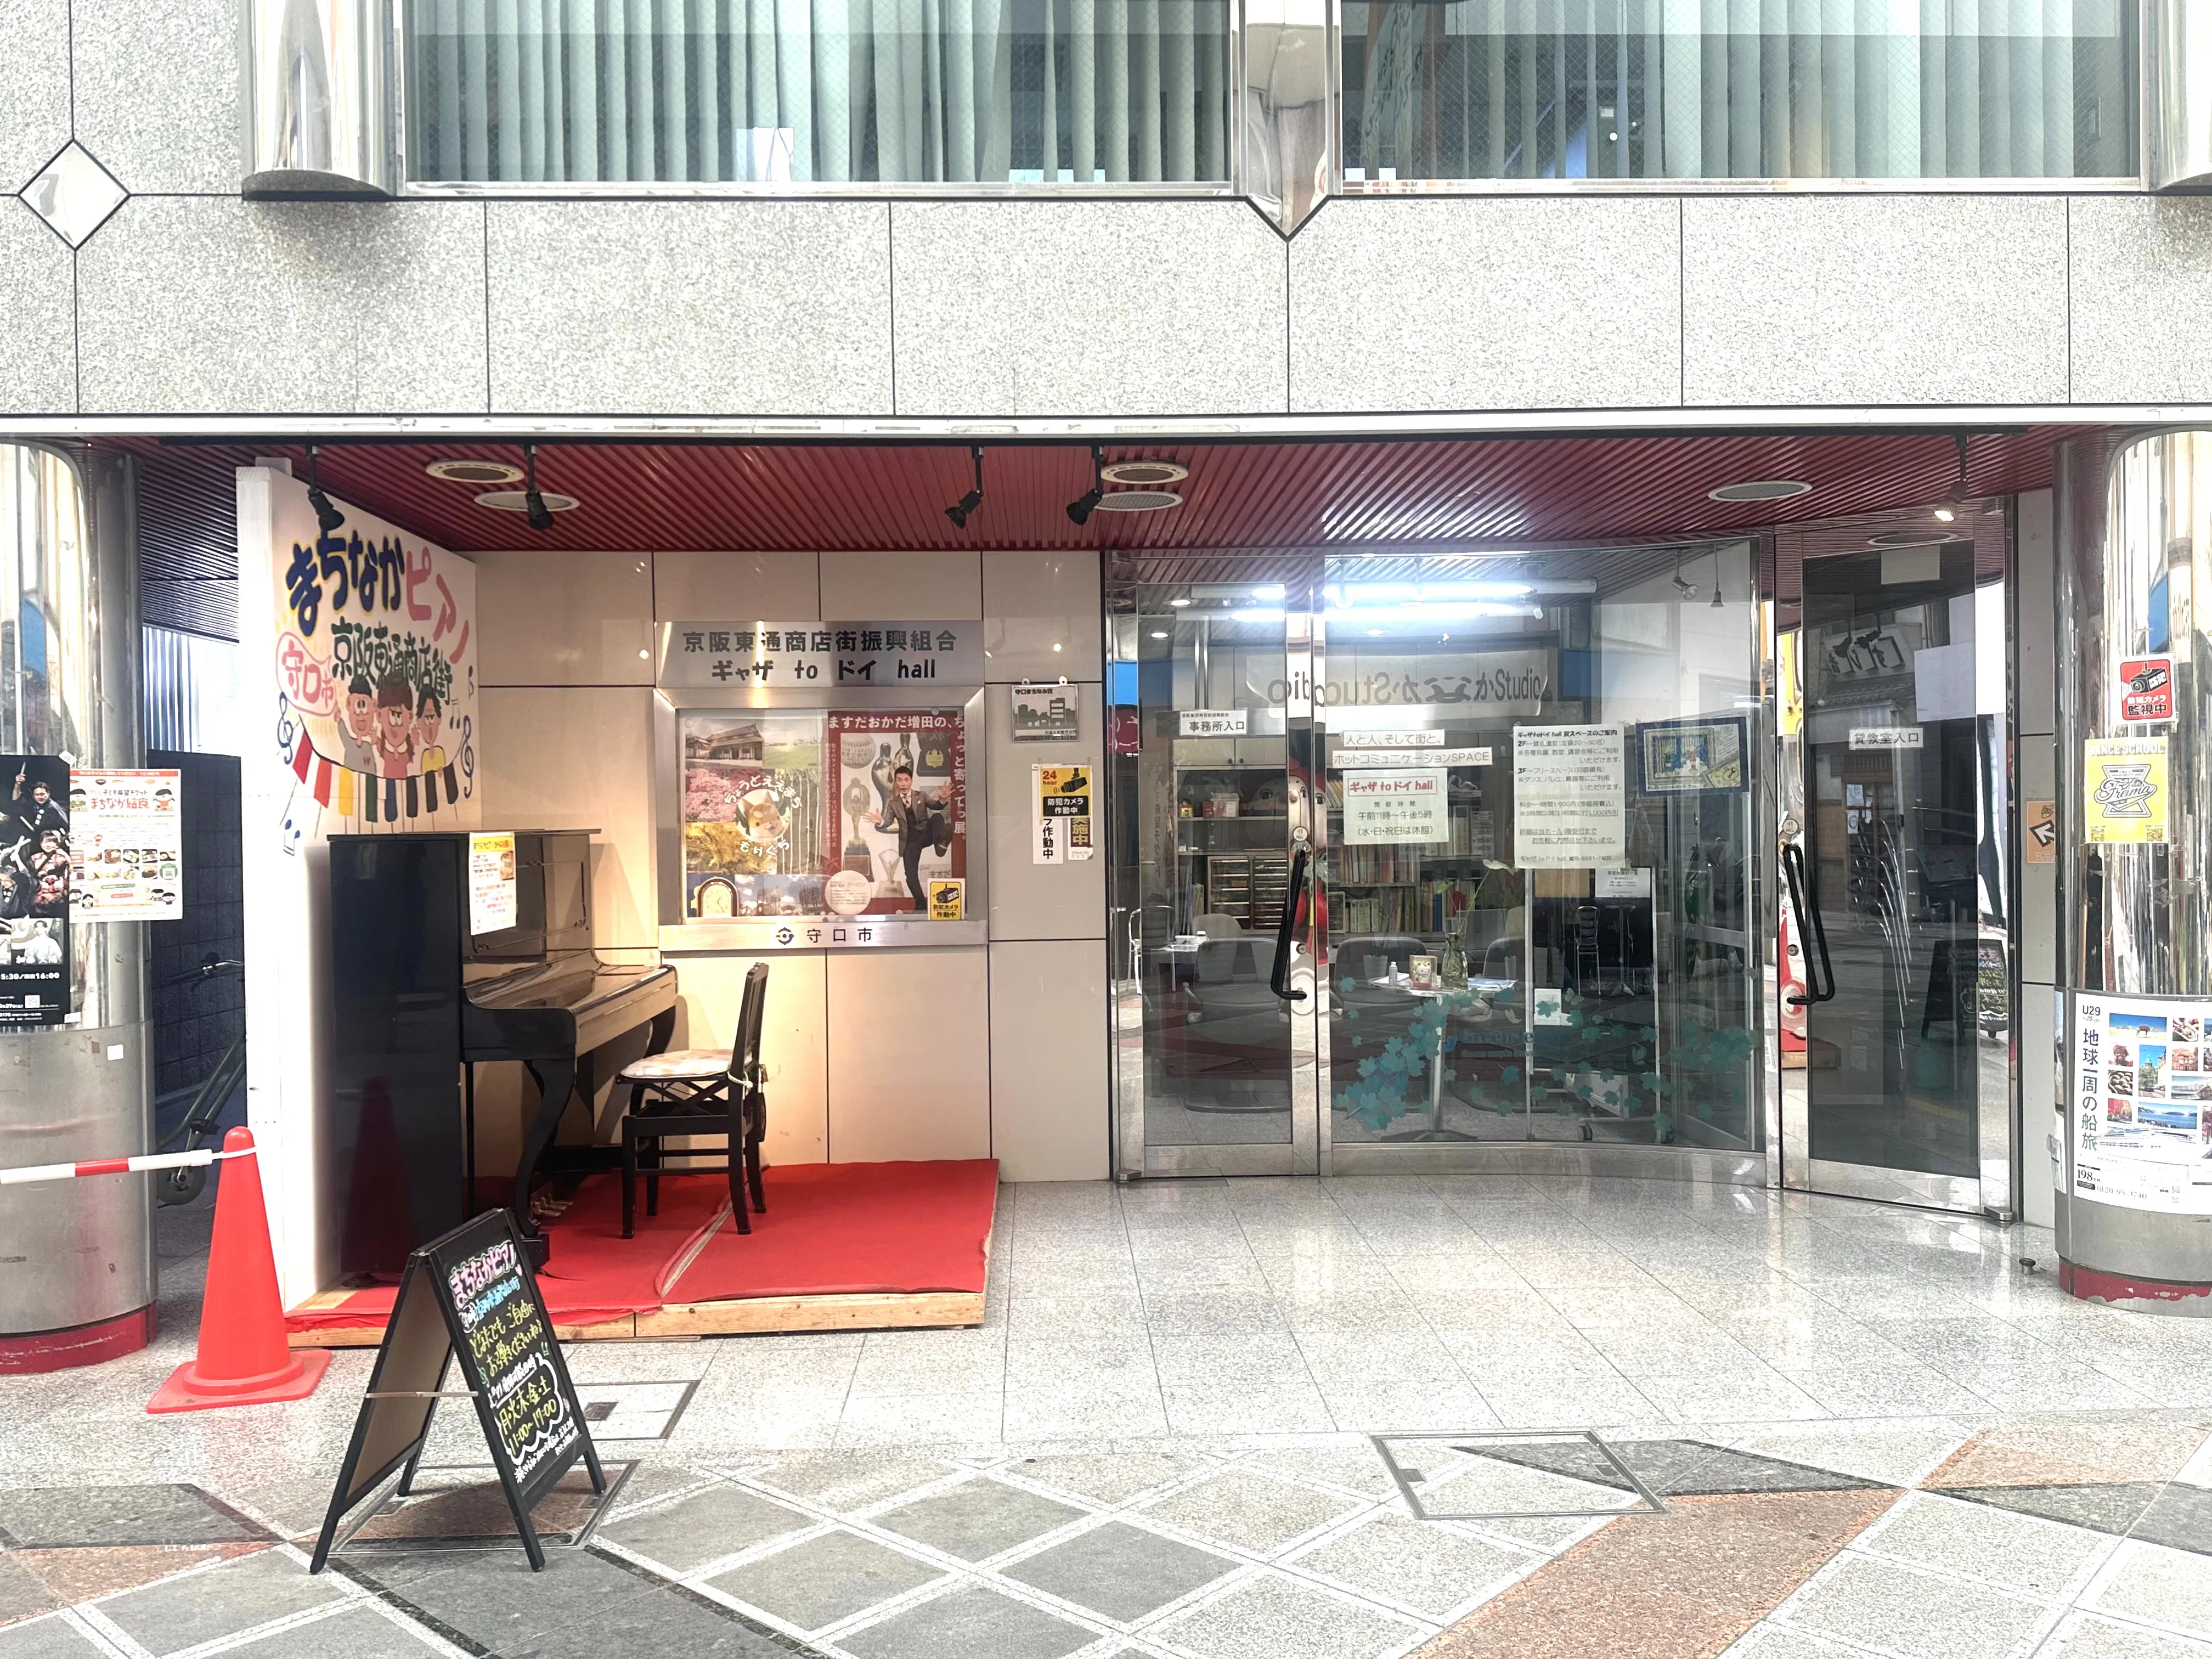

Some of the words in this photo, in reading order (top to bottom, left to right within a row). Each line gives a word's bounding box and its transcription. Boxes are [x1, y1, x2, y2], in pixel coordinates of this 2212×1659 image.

[286, 530, 469, 664] まちなかピアノ
[683, 630, 957, 652] 京阪東通商店街振興組合
[331, 616, 452, 705] 京阪東通商店街
[283, 643, 335, 705] 守口市
[712, 660, 774, 681] ギャザ
[794, 660, 818, 679] to
[838, 660, 877, 681] ドイ
[898, 659, 935, 678] hall
[2128, 695, 2166, 704] 防犯カメラ
[2128, 703, 2166, 715] 監視中
[1189, 721, 1244, 732] 事務所入口
[1043, 771, 1057, 780] 24
[1350, 781, 1378, 792] ギャザ
[1380, 781, 1391, 791] to
[1394, 781, 1412, 792] ドイ
[1415, 780, 1433, 791] hall
[1054, 806, 1078, 815] 作動中
[806, 928, 872, 943] 守口市
[2083, 1005, 2101, 1016] U29
[2081, 1028, 2099, 1152] 地球一周の船旅
[449, 1240, 516, 1311] まちなかピアノ
[470, 1317, 505, 1358] どなたでも
[506, 1299, 535, 1328] ご自由に
